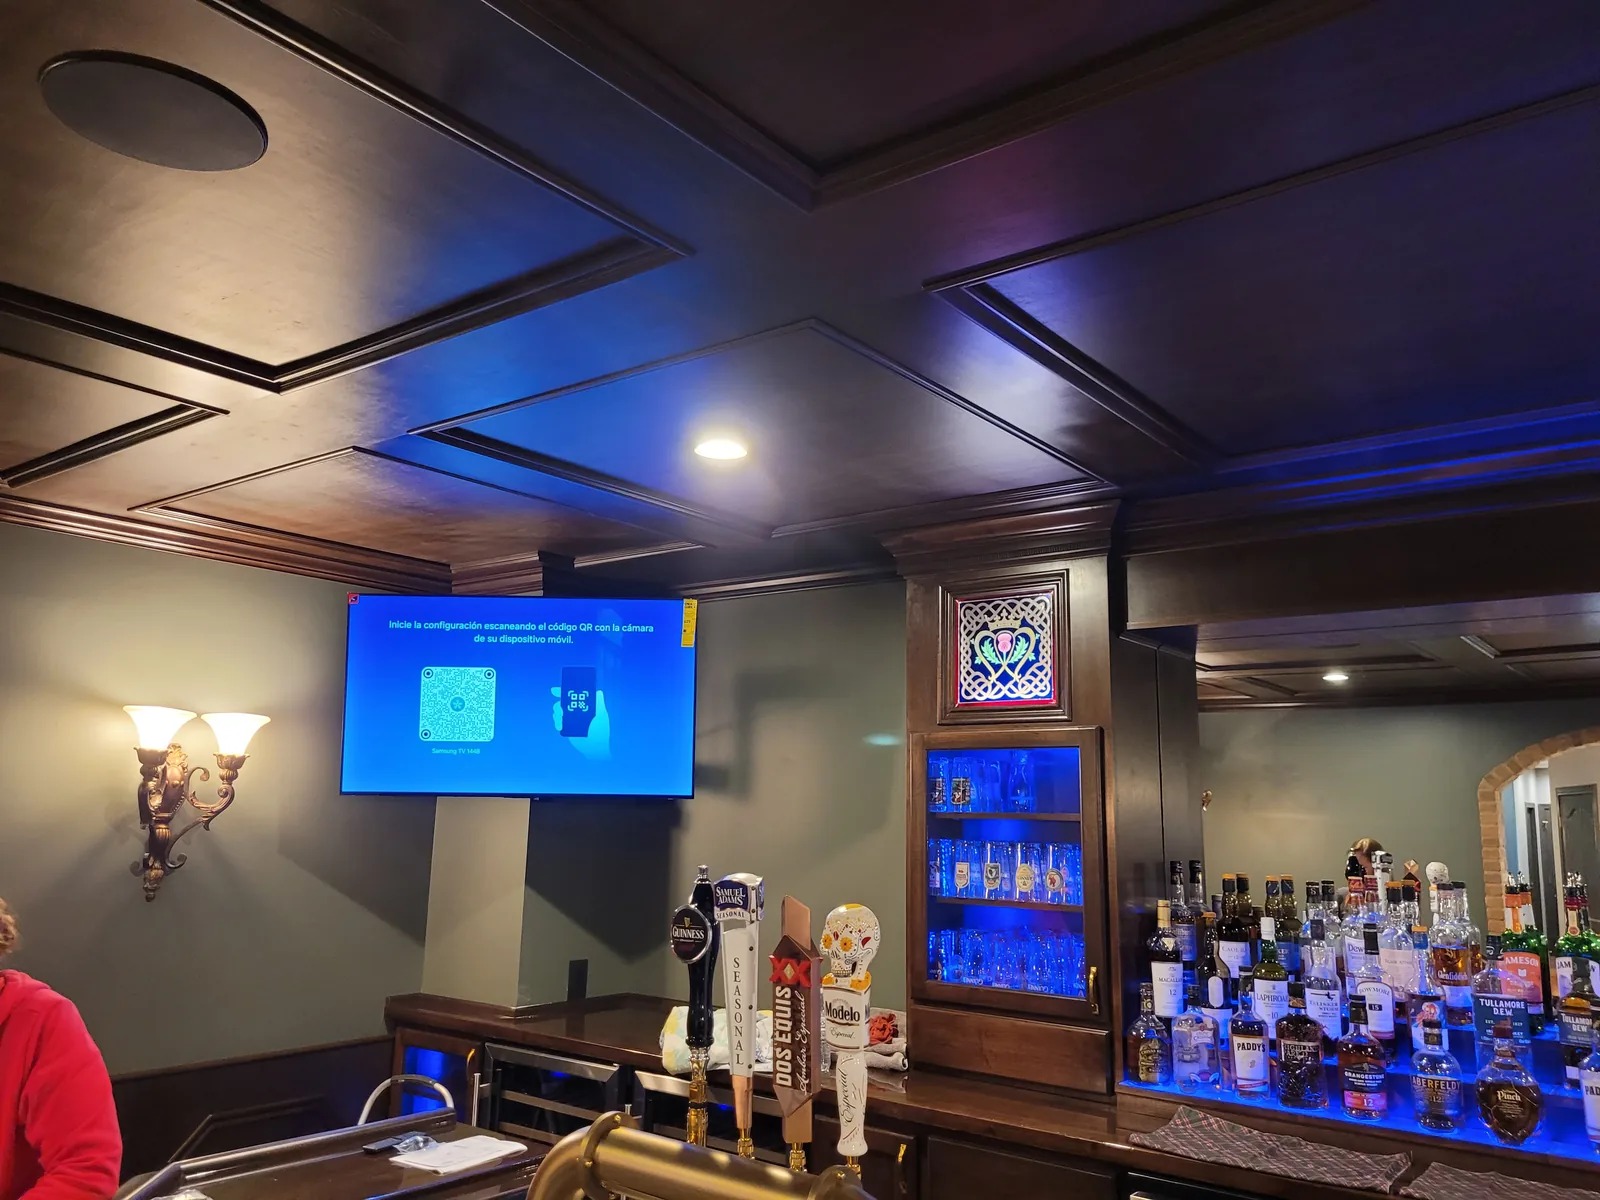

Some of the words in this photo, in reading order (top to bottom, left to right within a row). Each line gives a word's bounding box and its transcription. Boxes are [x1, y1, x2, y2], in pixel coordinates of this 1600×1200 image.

[389, 620, 412, 629] Inicie
[414, 620, 422, 629] la
[423, 620, 482, 631] configuración
[484, 622, 537, 631] escaneando
[538, 622, 546, 631] el
[548, 622, 577, 633] código
[579, 623, 593, 632] QR
[594, 624, 611, 632] con
[612, 623, 620, 632] la
[622, 623, 654, 632] cámara
[473, 634, 485, 643] de
[487, 635, 498, 643] su
[499, 634, 546, 645] dispositivo
[547, 635, 574, 644] móvil.
[715, 886, 746, 898] SAMUEL
[717, 896, 744, 906] ADAMS
[716, 910, 745, 919] SEASONAL
[672, 926, 705, 939] GUINNESS
[1505, 956, 1539, 967] AMESON
[1479, 998, 1525, 1009] TULLAMORE
[733, 957, 744, 1065] SEASONAL
[775, 985, 793, 1044] EQUIS
[794, 990, 811, 1044] Especial
[825, 1000, 861, 1021] Modelo
[776, 1047, 792, 1087] DOS
[1412, 1076, 1460, 1090] ABERFELDY
[1497, 1089, 1521, 1102] Pinch
[1363, 1098, 1374, 1107] 12
